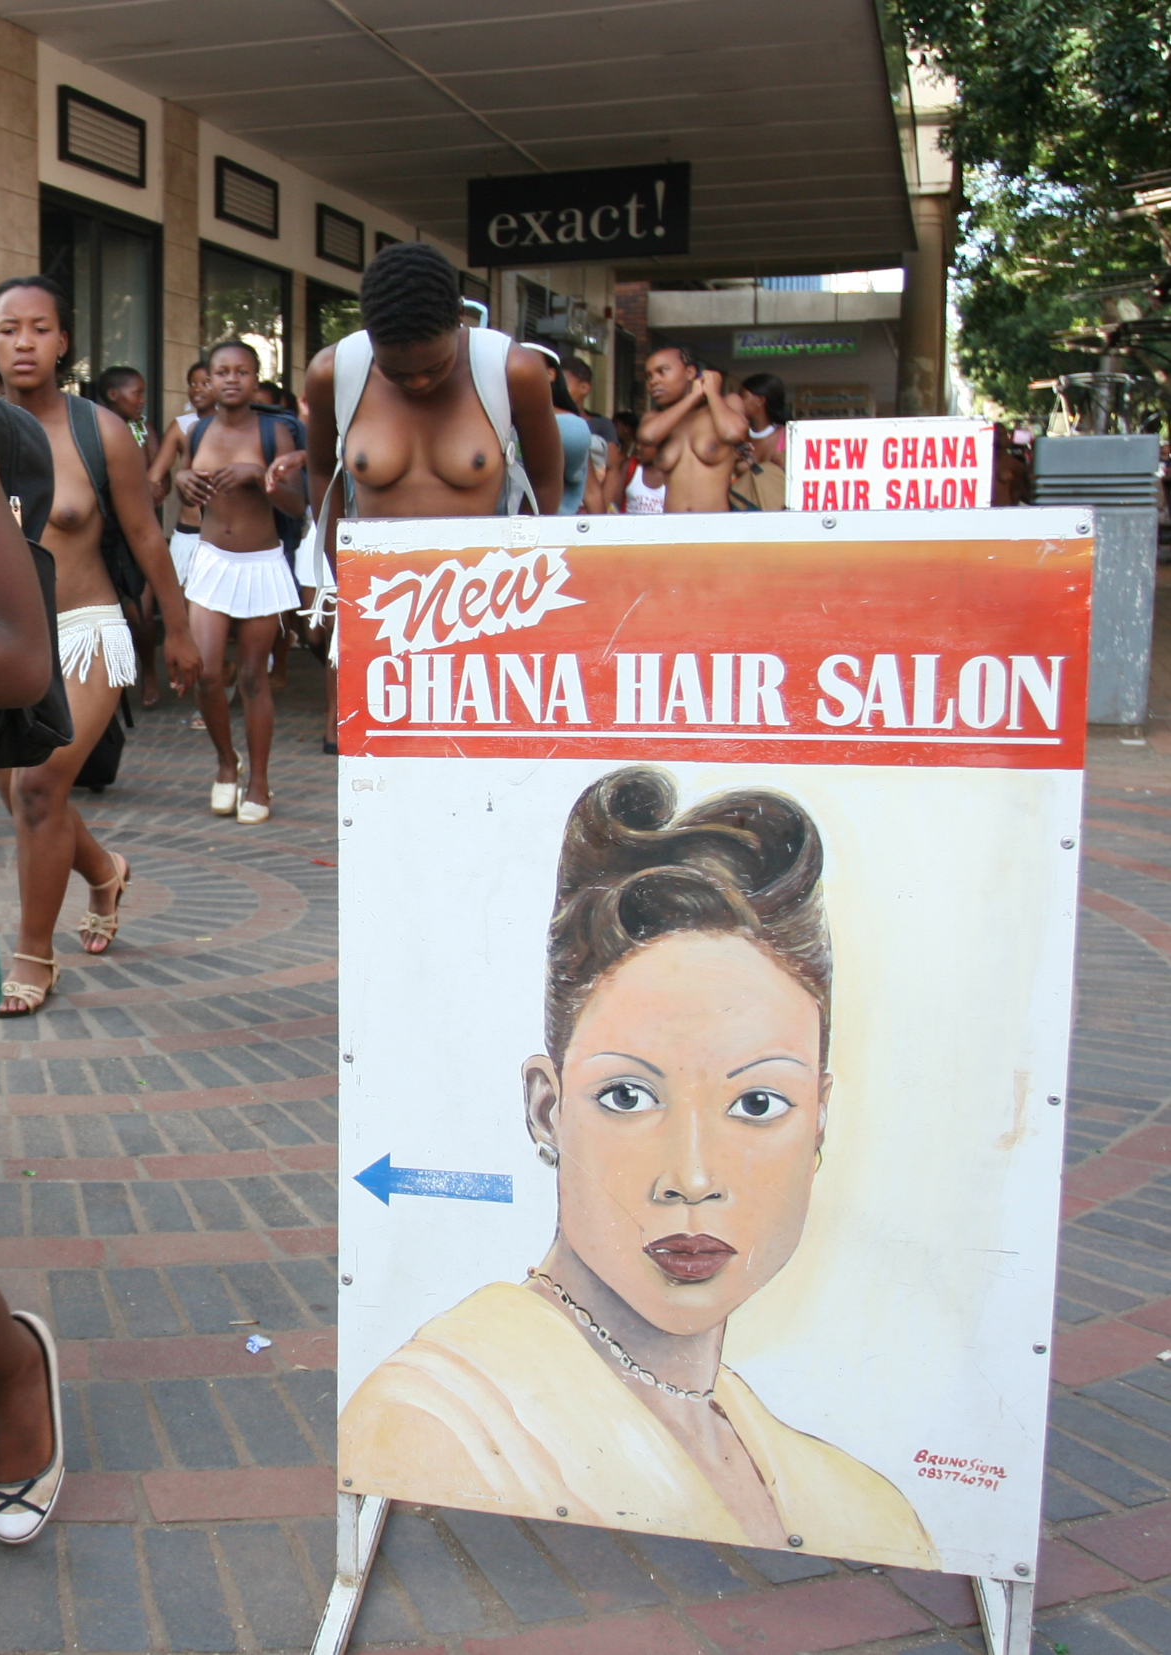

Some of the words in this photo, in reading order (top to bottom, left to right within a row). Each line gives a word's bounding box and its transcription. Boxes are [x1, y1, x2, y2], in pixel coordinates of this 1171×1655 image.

[487, 179, 666, 248] exact!
[804, 437, 868, 470] NEW
[882, 436, 978, 469] GHANA
[802, 480, 869, 511] HAIR
[885, 478, 978, 509] SALON
[375, 553, 560, 643] New
[365, 652, 591, 726] GHANA
[613, 652, 789, 728] HAIR
[816, 652, 1063, 730] SALON
[917, 1467, 999, 1492] 0837740791
